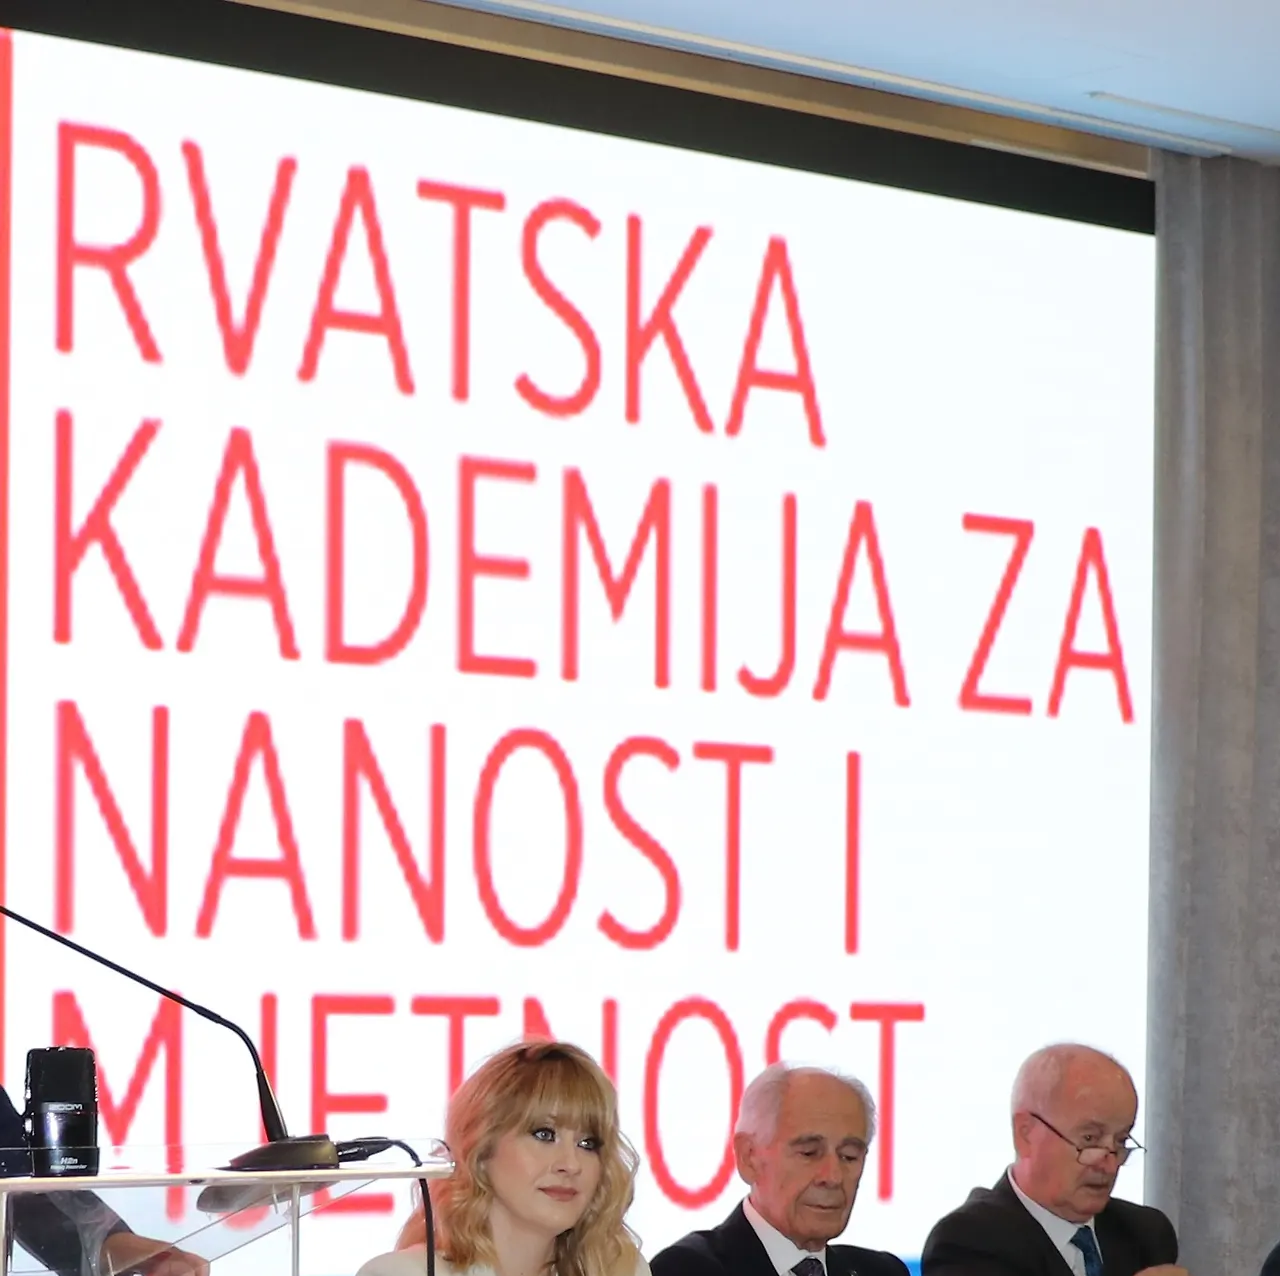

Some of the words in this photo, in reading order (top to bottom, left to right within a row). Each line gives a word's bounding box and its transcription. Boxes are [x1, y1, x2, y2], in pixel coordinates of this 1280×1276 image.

[958, 513, 1134, 724] ZA
[55, 700, 774, 952] NANOST
[844, 751, 860, 954] I
